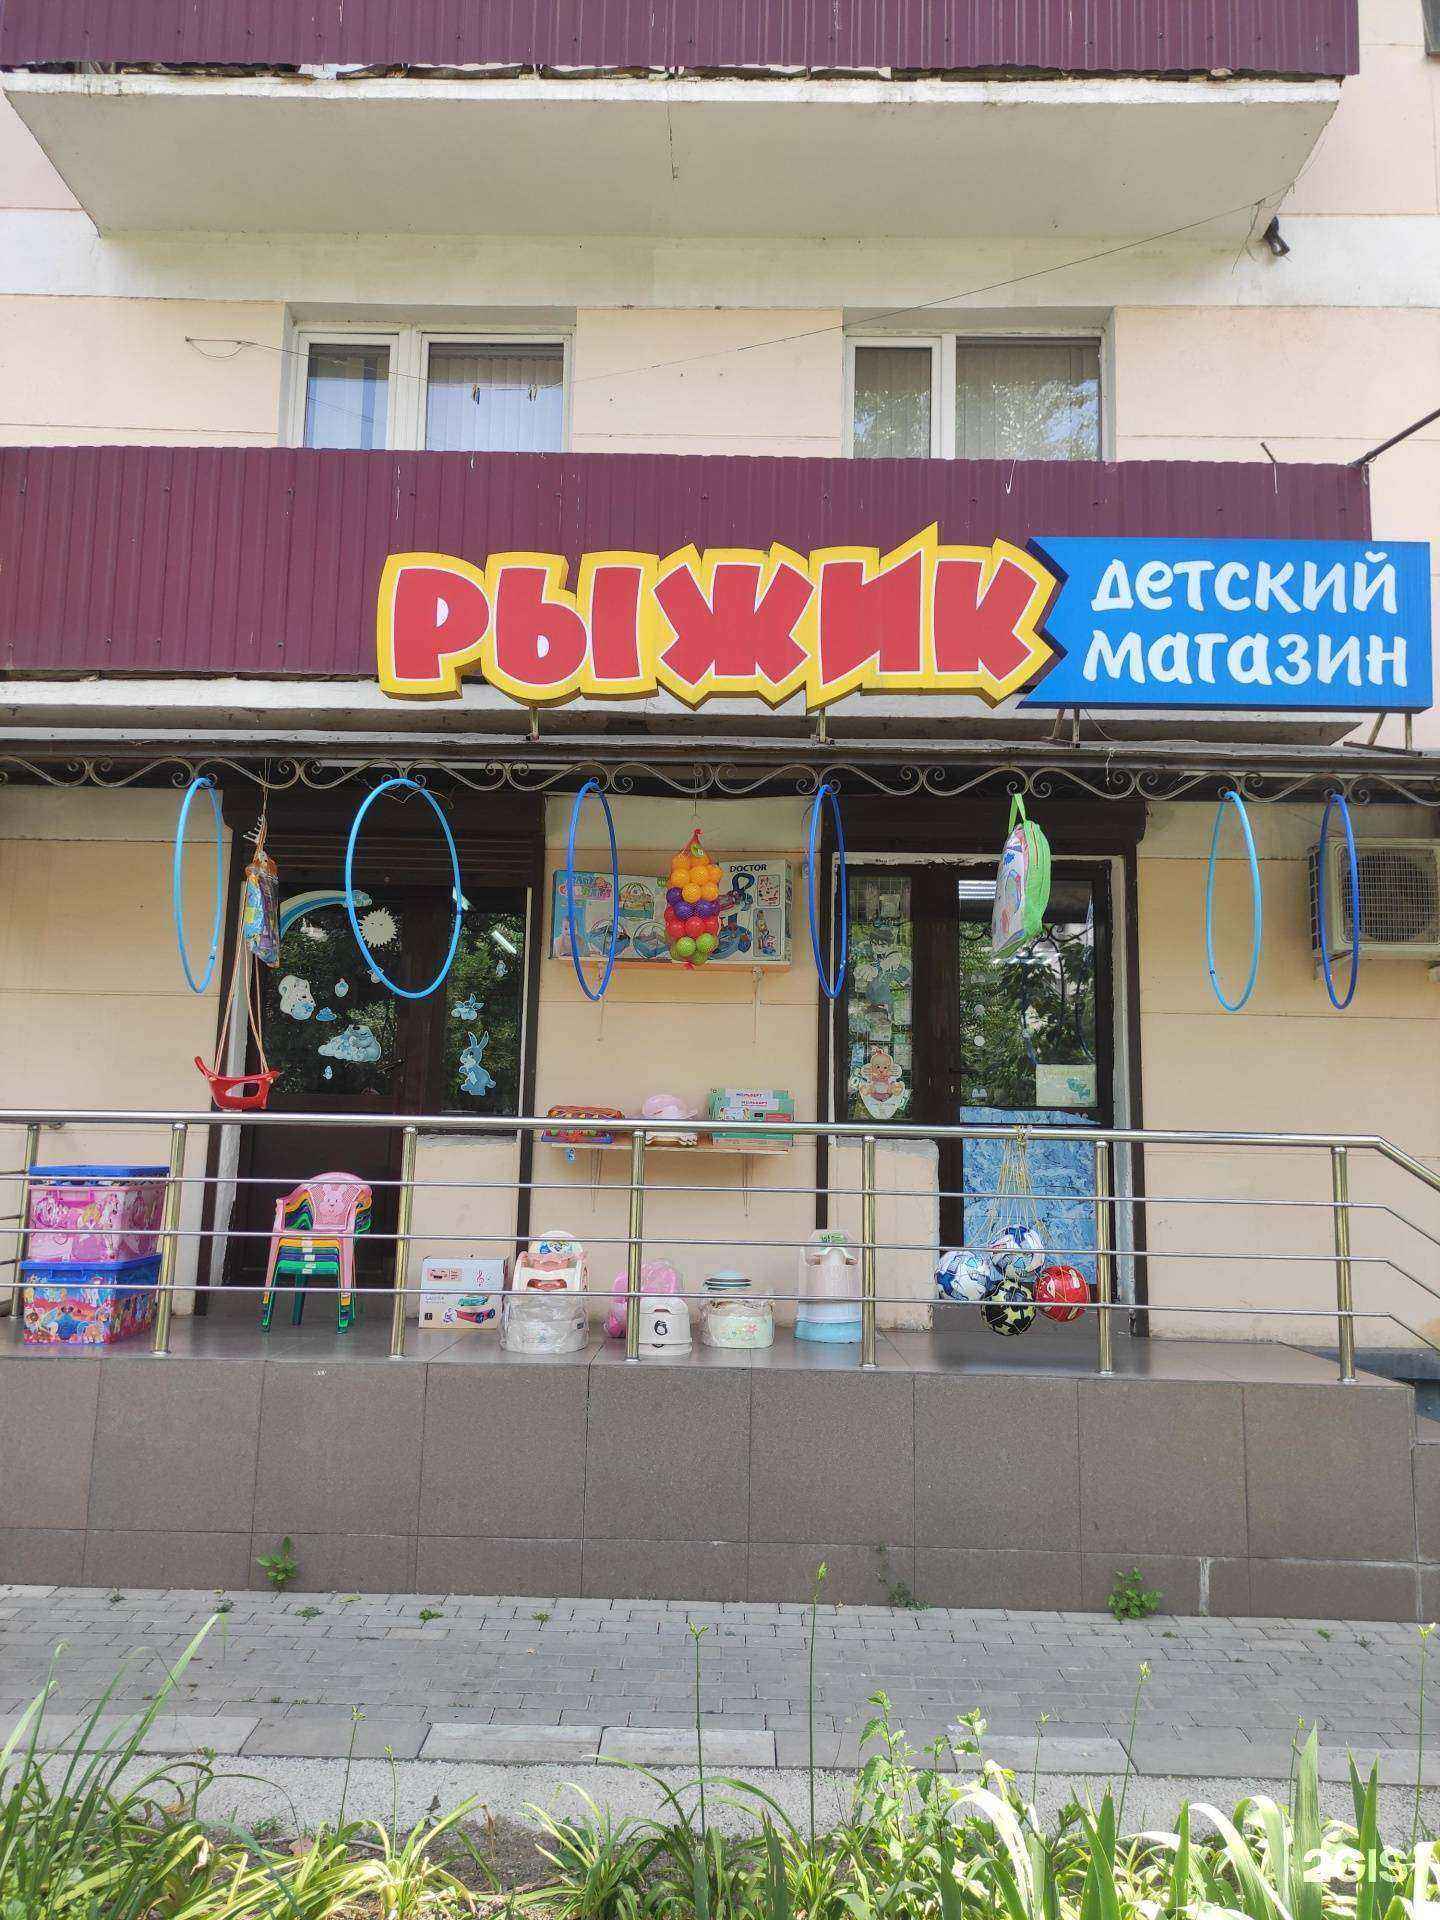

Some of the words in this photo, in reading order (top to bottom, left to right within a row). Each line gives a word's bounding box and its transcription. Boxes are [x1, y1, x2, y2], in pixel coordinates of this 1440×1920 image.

[385, 542, 1046, 696] РЫЖИК
[1083, 630, 1408, 687] магазин
[730, 863, 768, 872] DOCTOR
